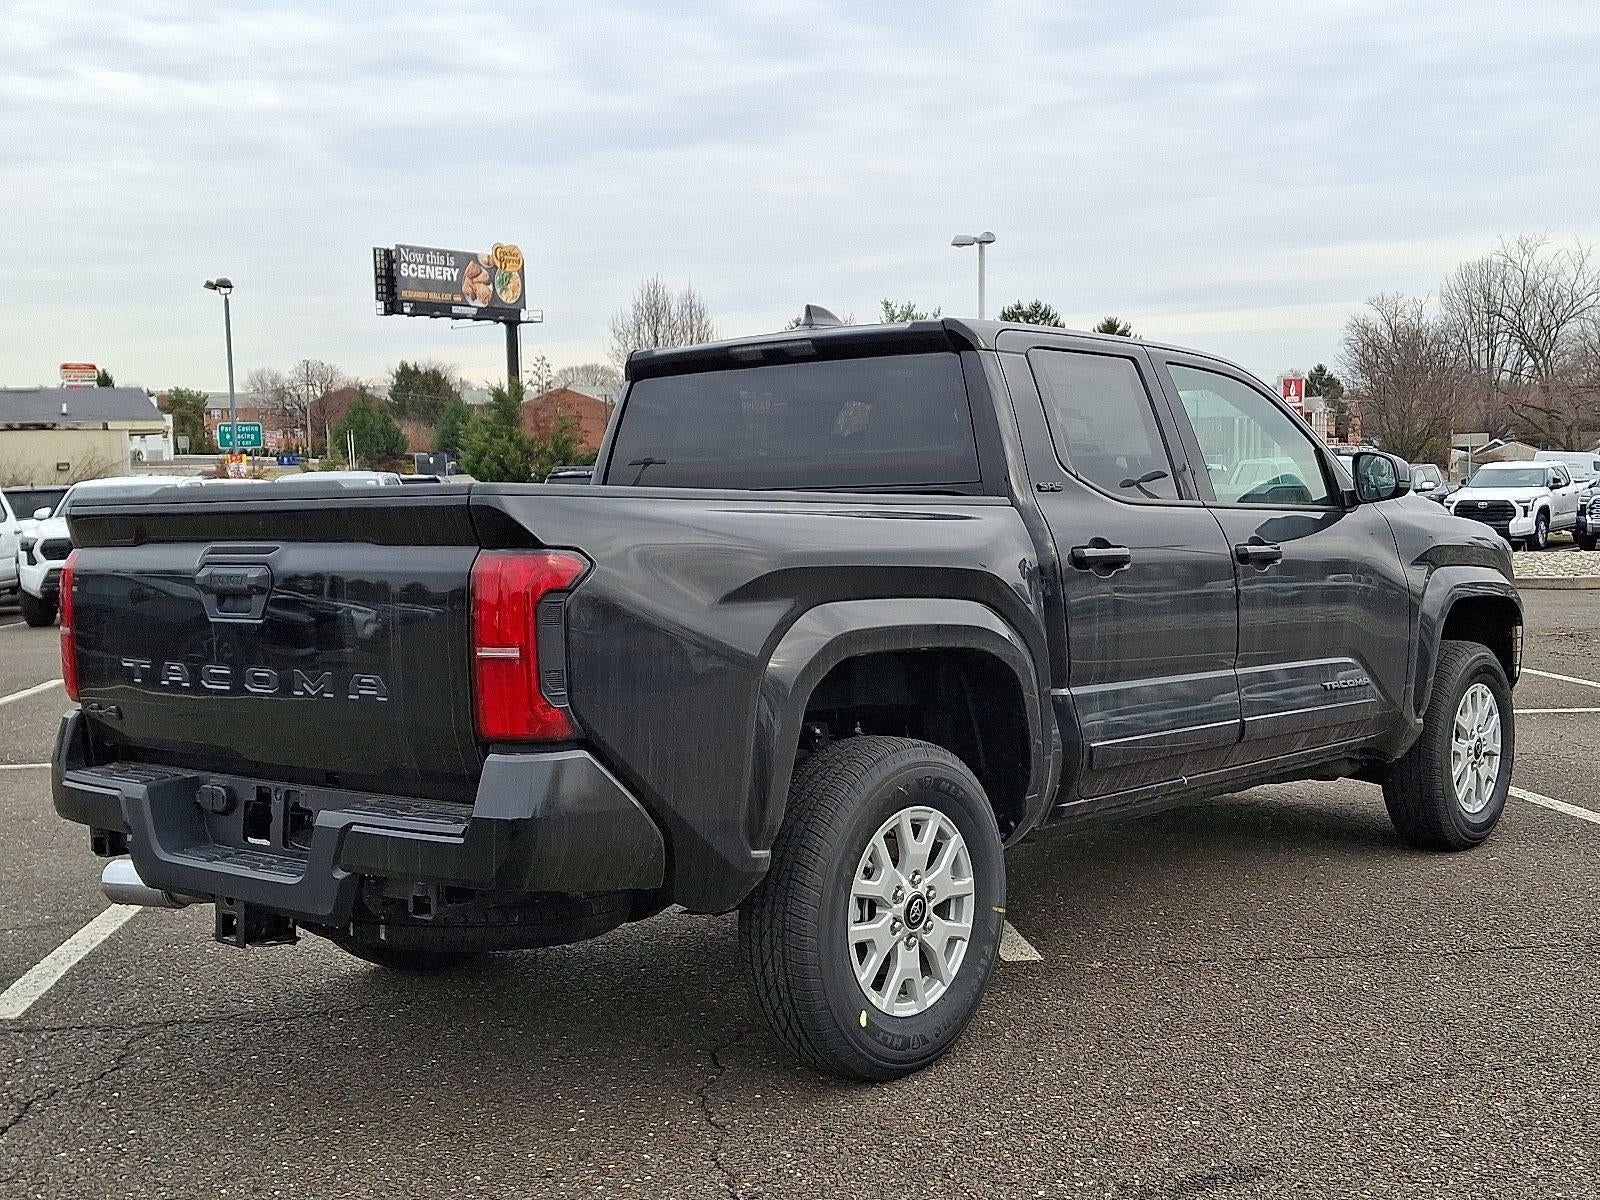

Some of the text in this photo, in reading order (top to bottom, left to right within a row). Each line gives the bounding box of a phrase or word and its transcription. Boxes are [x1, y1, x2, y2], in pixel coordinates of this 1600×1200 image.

[400, 247, 455, 267] Now this is
[400, 262, 460, 282] SCENERY
[121, 657, 389, 701] TACOMA
[1321, 677, 1371, 691] TACOMA
